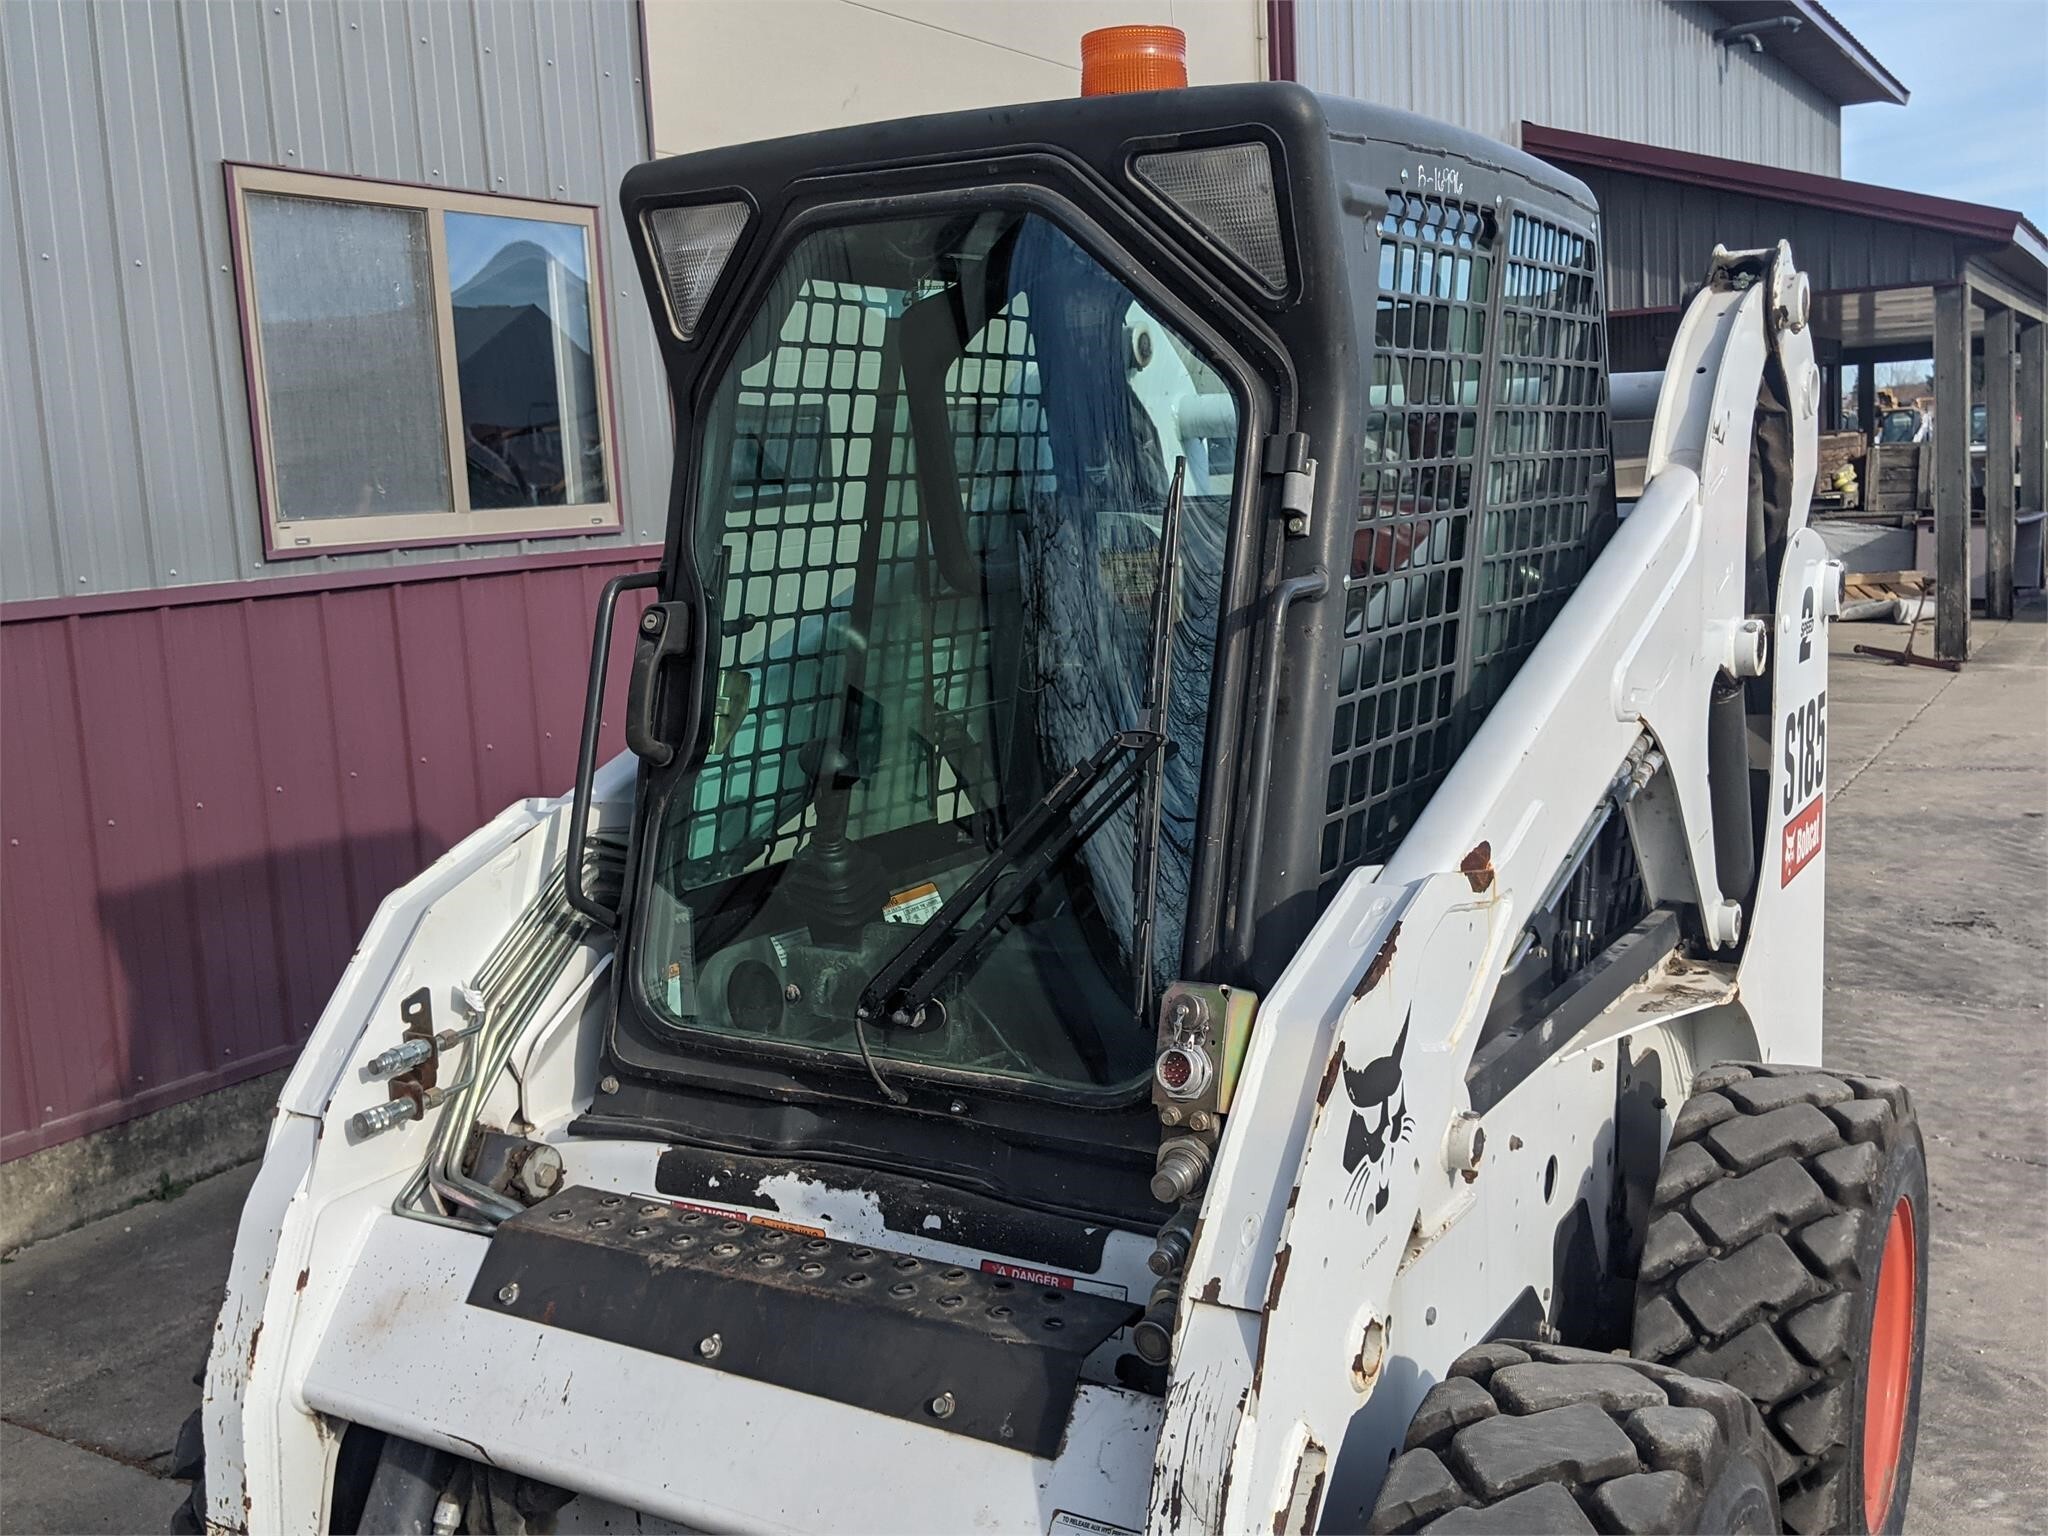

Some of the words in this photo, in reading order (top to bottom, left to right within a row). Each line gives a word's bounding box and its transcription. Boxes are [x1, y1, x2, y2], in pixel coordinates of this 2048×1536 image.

[1783, 690, 1826, 817] S185
[1796, 811, 1821, 865] Bobcat
[1011, 1268, 1059, 1288] DANGER
